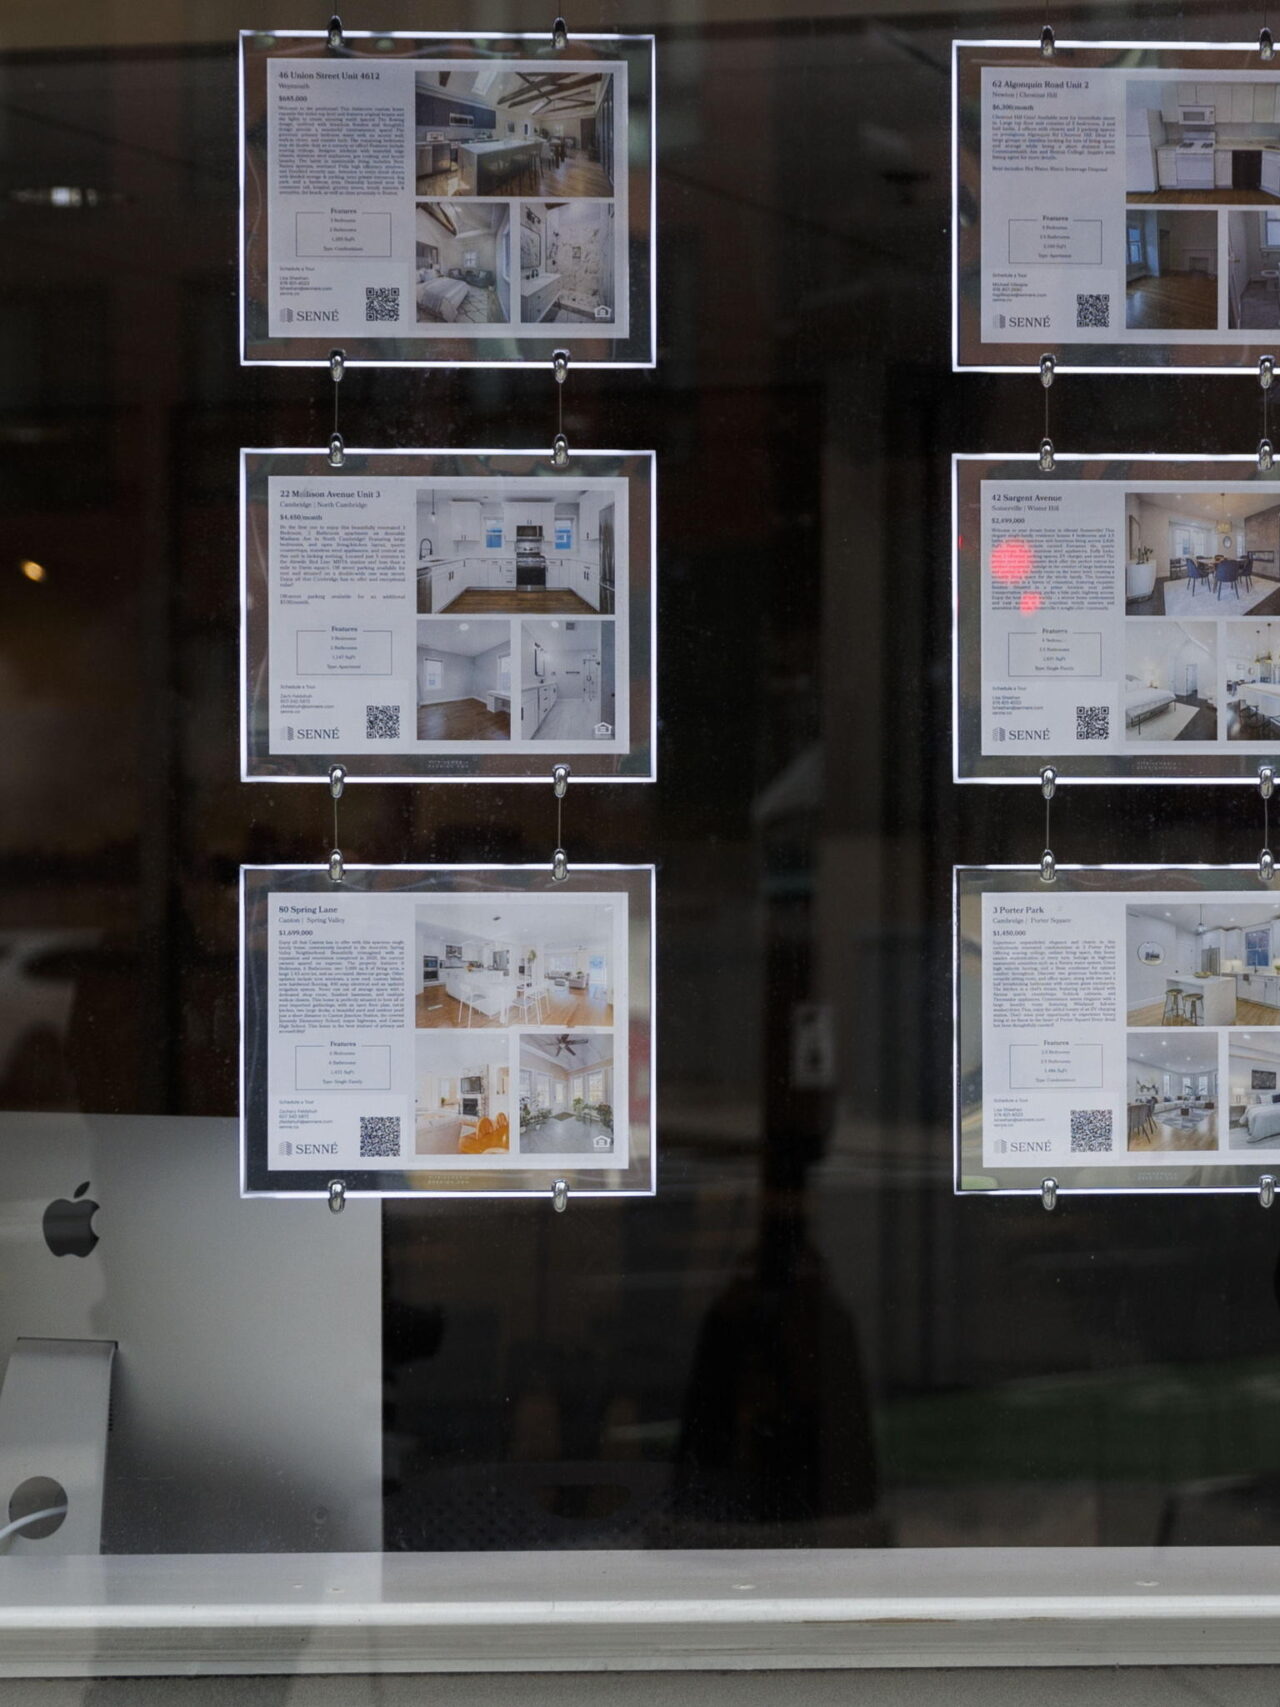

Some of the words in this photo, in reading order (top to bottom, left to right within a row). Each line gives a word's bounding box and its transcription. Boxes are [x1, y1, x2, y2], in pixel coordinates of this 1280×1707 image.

[992, 80, 1001, 88] 62
[1004, 81, 1042, 89] Algonquin
[1044, 80, 1064, 88] Road
[1066, 80, 1081, 88] Unit
[1084, 80, 1089, 88] 2
[296, 309, 339, 321] SENNÉ
[1009, 314, 1050, 328] SENNÉ
[280, 490, 290, 498] 22
[327, 490, 355, 498] Avenue
[357, 490, 373, 498] Unit
[376, 490, 380, 498] 3
[1003, 494, 1032, 503] Sargent
[336, 501, 367, 509] Cambridge
[297, 726, 340, 739] SENNÉ
[1009, 728, 1050, 740] SENNÉ
[290, 906, 317, 914] Spring
[296, 1141, 338, 1154] SENNÉ
[1010, 1139, 1052, 1152] SENNÉ
